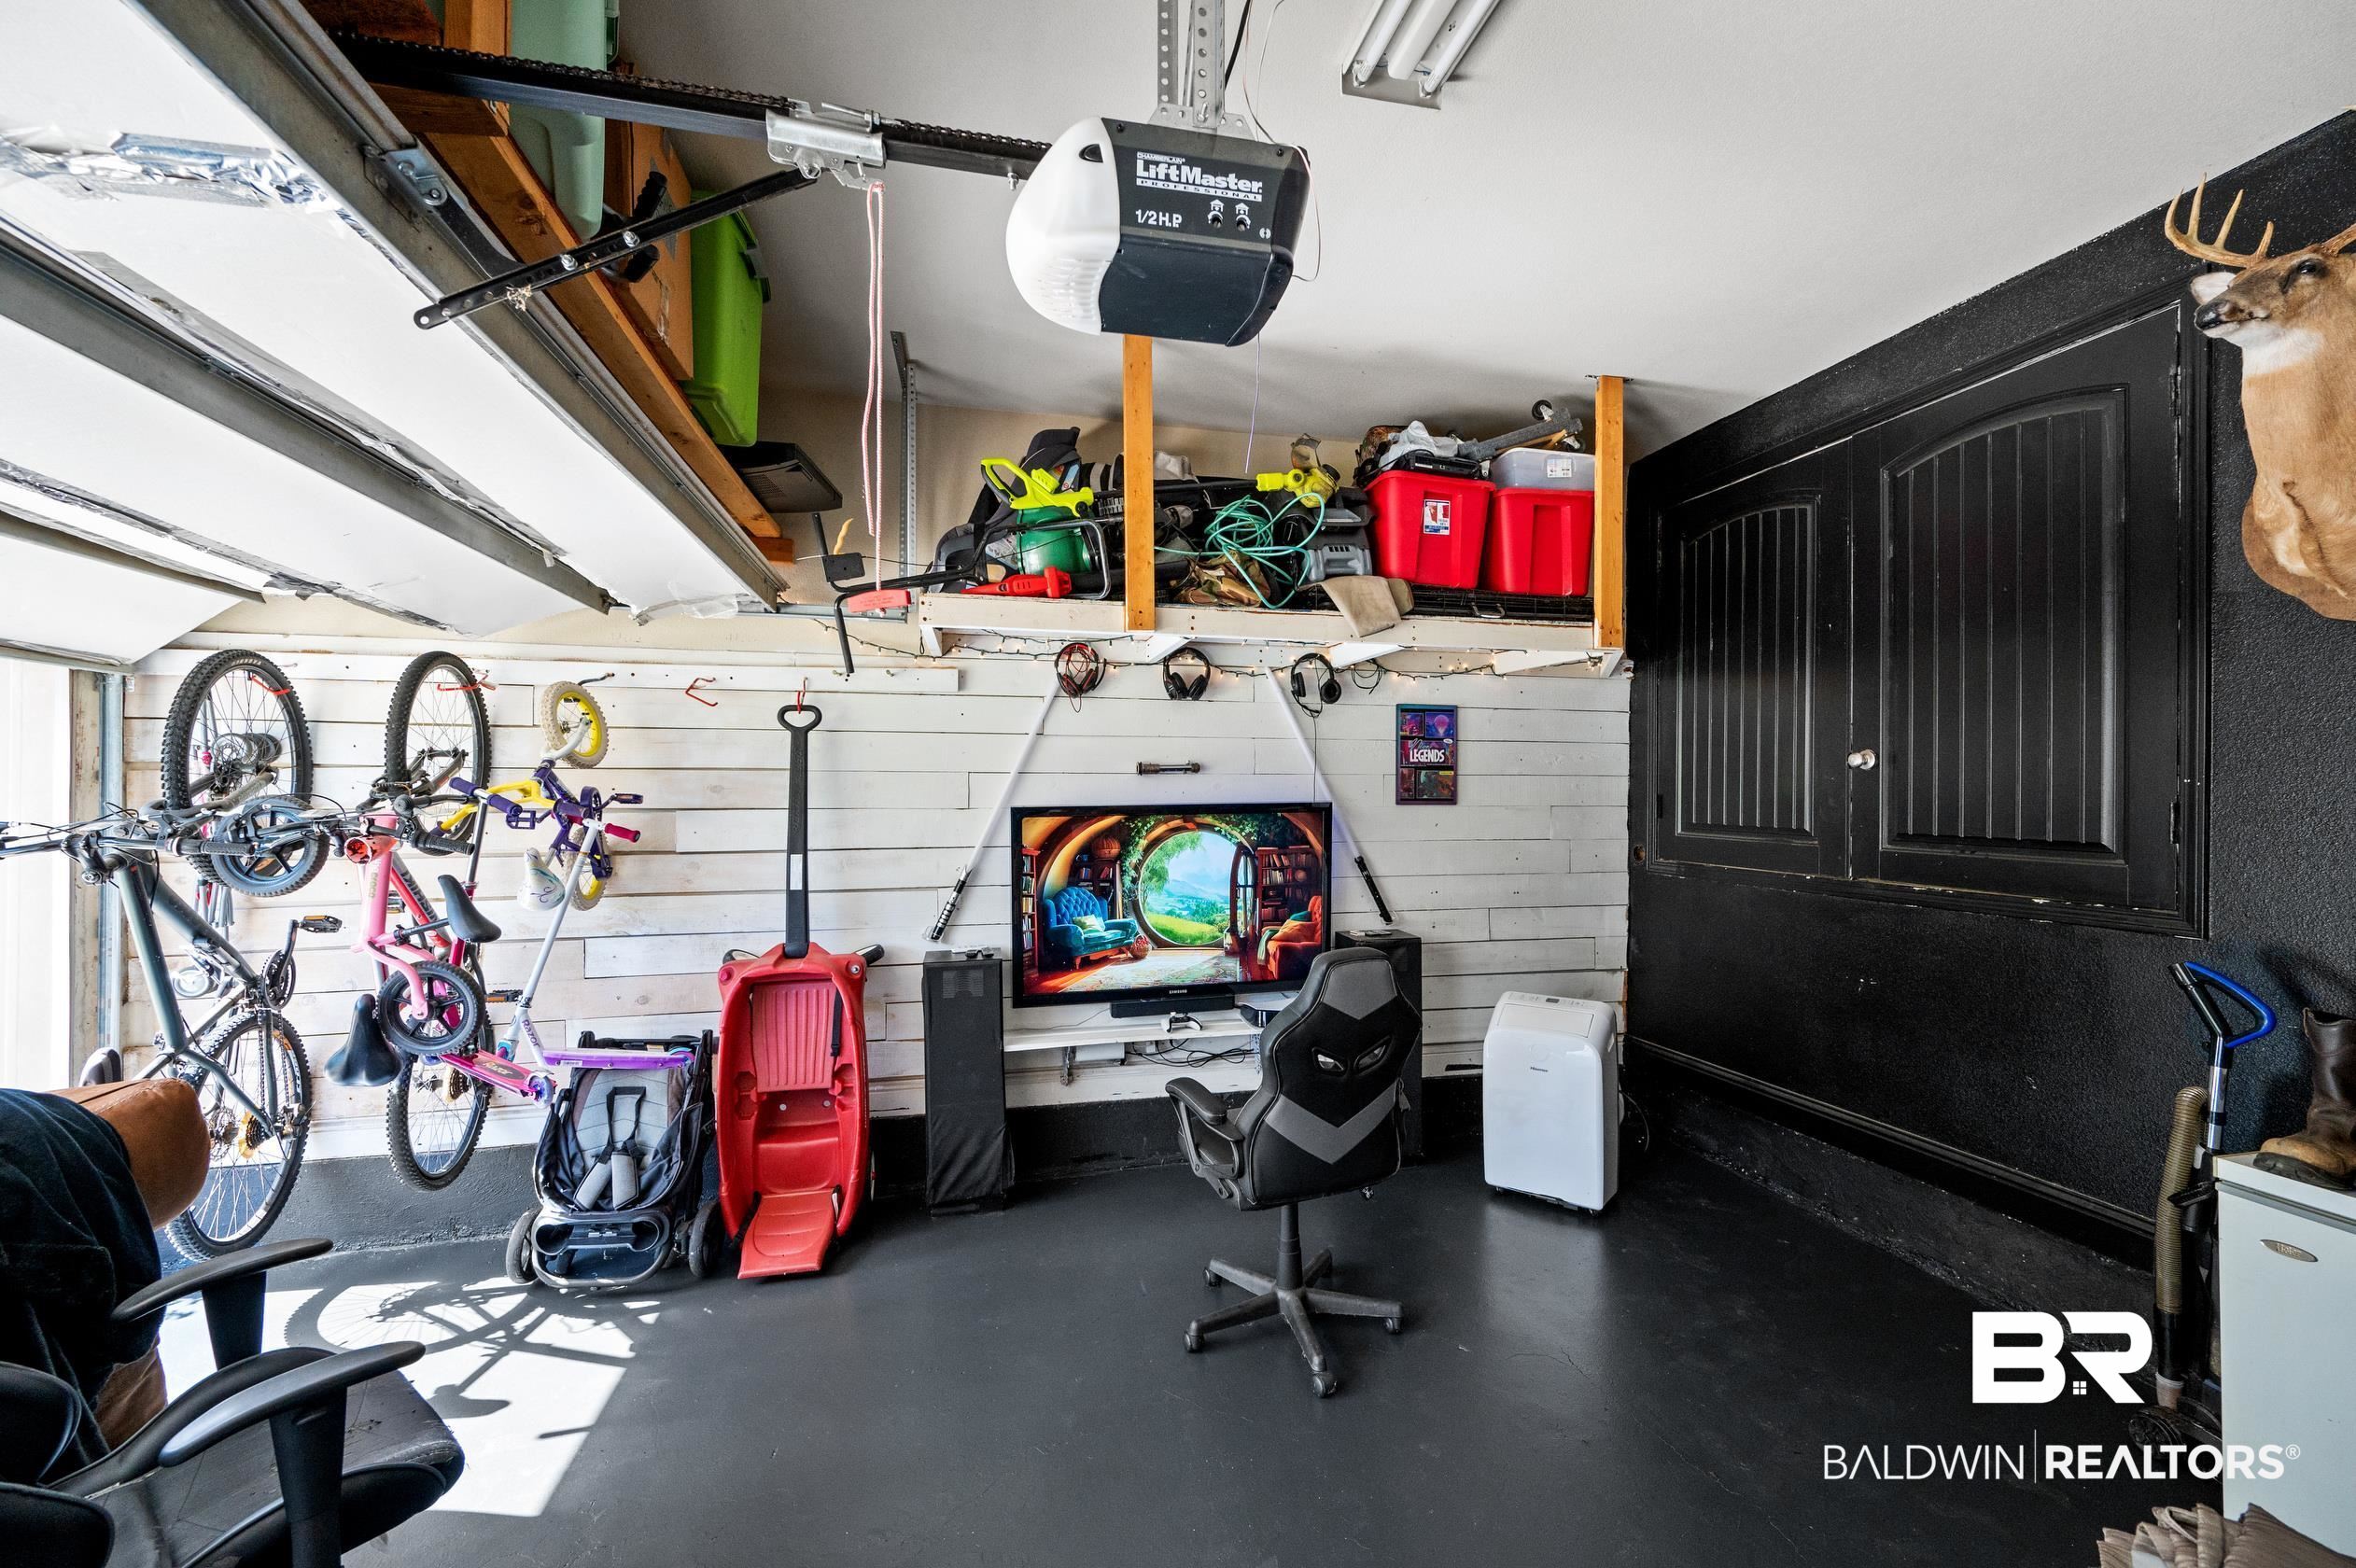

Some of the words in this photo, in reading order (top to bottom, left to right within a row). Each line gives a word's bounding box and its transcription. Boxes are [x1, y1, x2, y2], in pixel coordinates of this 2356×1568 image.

[1140, 180, 1260, 202] PROFESSIONAL
[1410, 749, 1445, 763] LEGENDS
[522, 1018, 540, 1047] Razor
